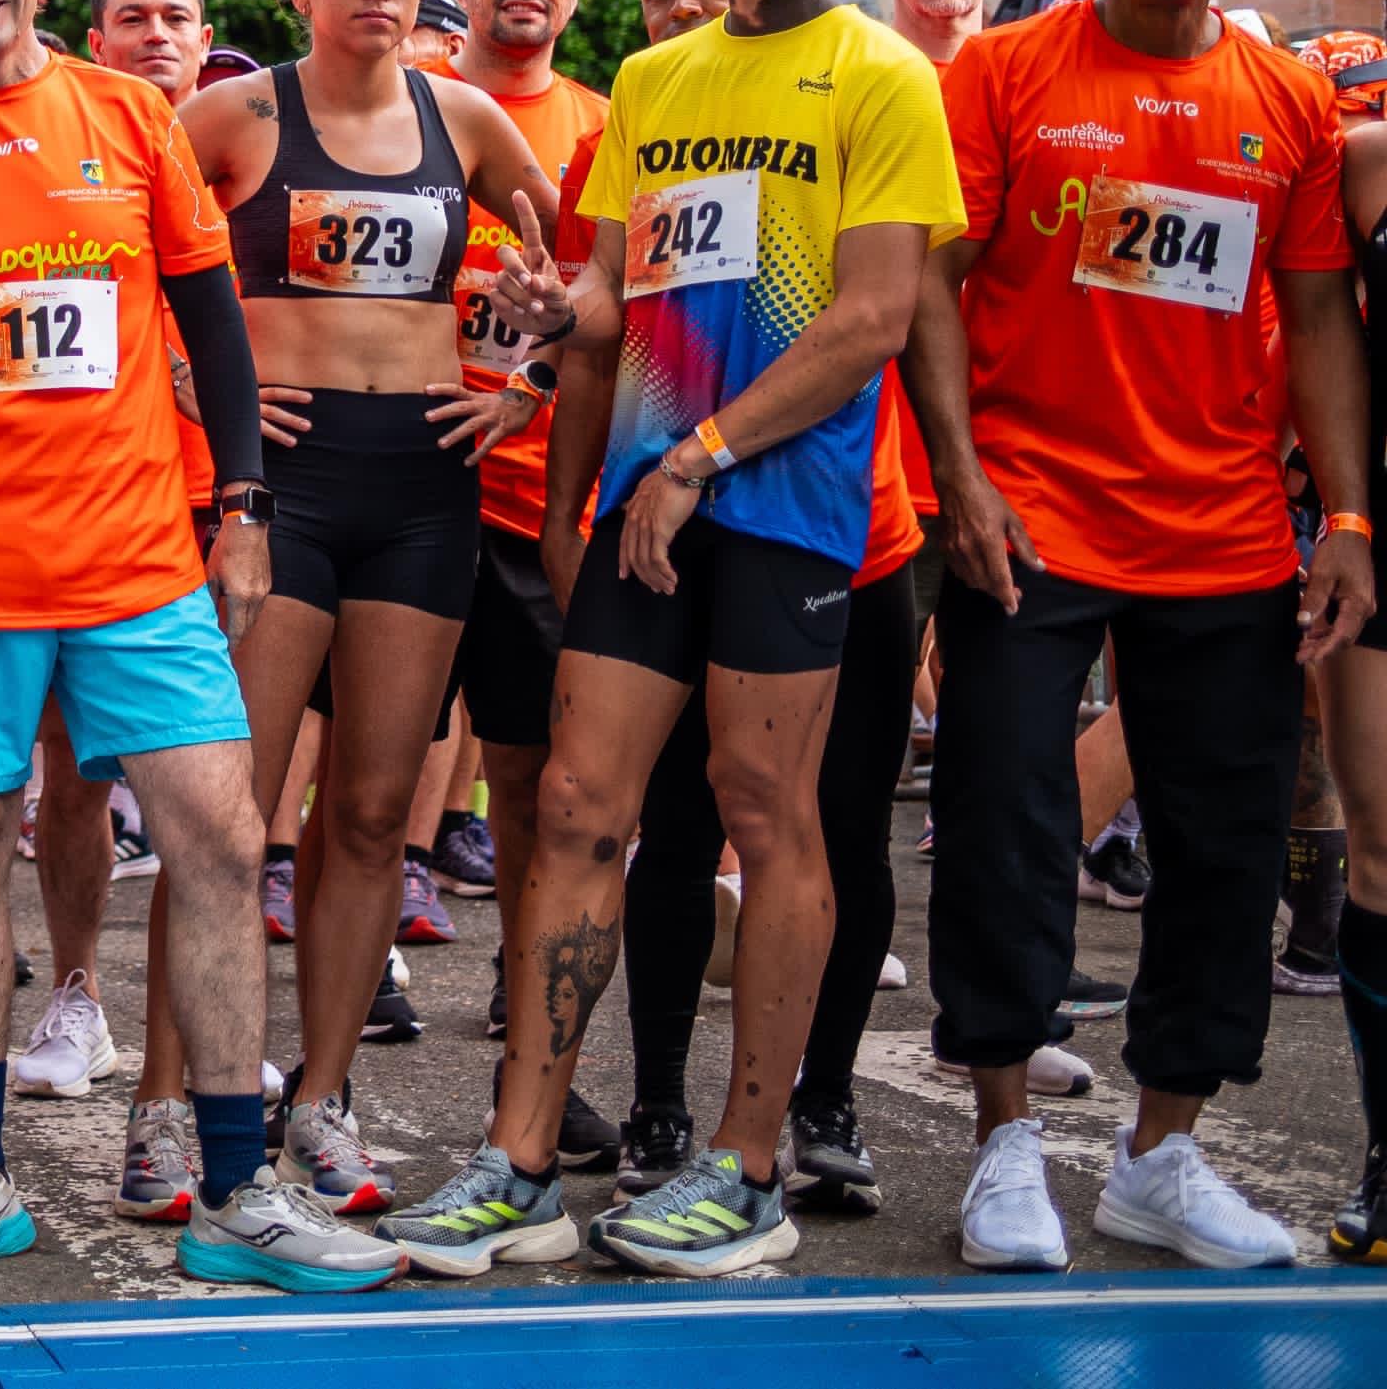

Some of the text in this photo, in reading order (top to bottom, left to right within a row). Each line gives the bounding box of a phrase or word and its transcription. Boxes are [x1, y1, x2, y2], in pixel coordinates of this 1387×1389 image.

[1036, 124, 1125, 145] Comfenalco
[317, 214, 413, 268] 323
[648, 200, 723, 266] 242
[1113, 207, 1221, 275] 284
[0, 303, 83, 359] 112
